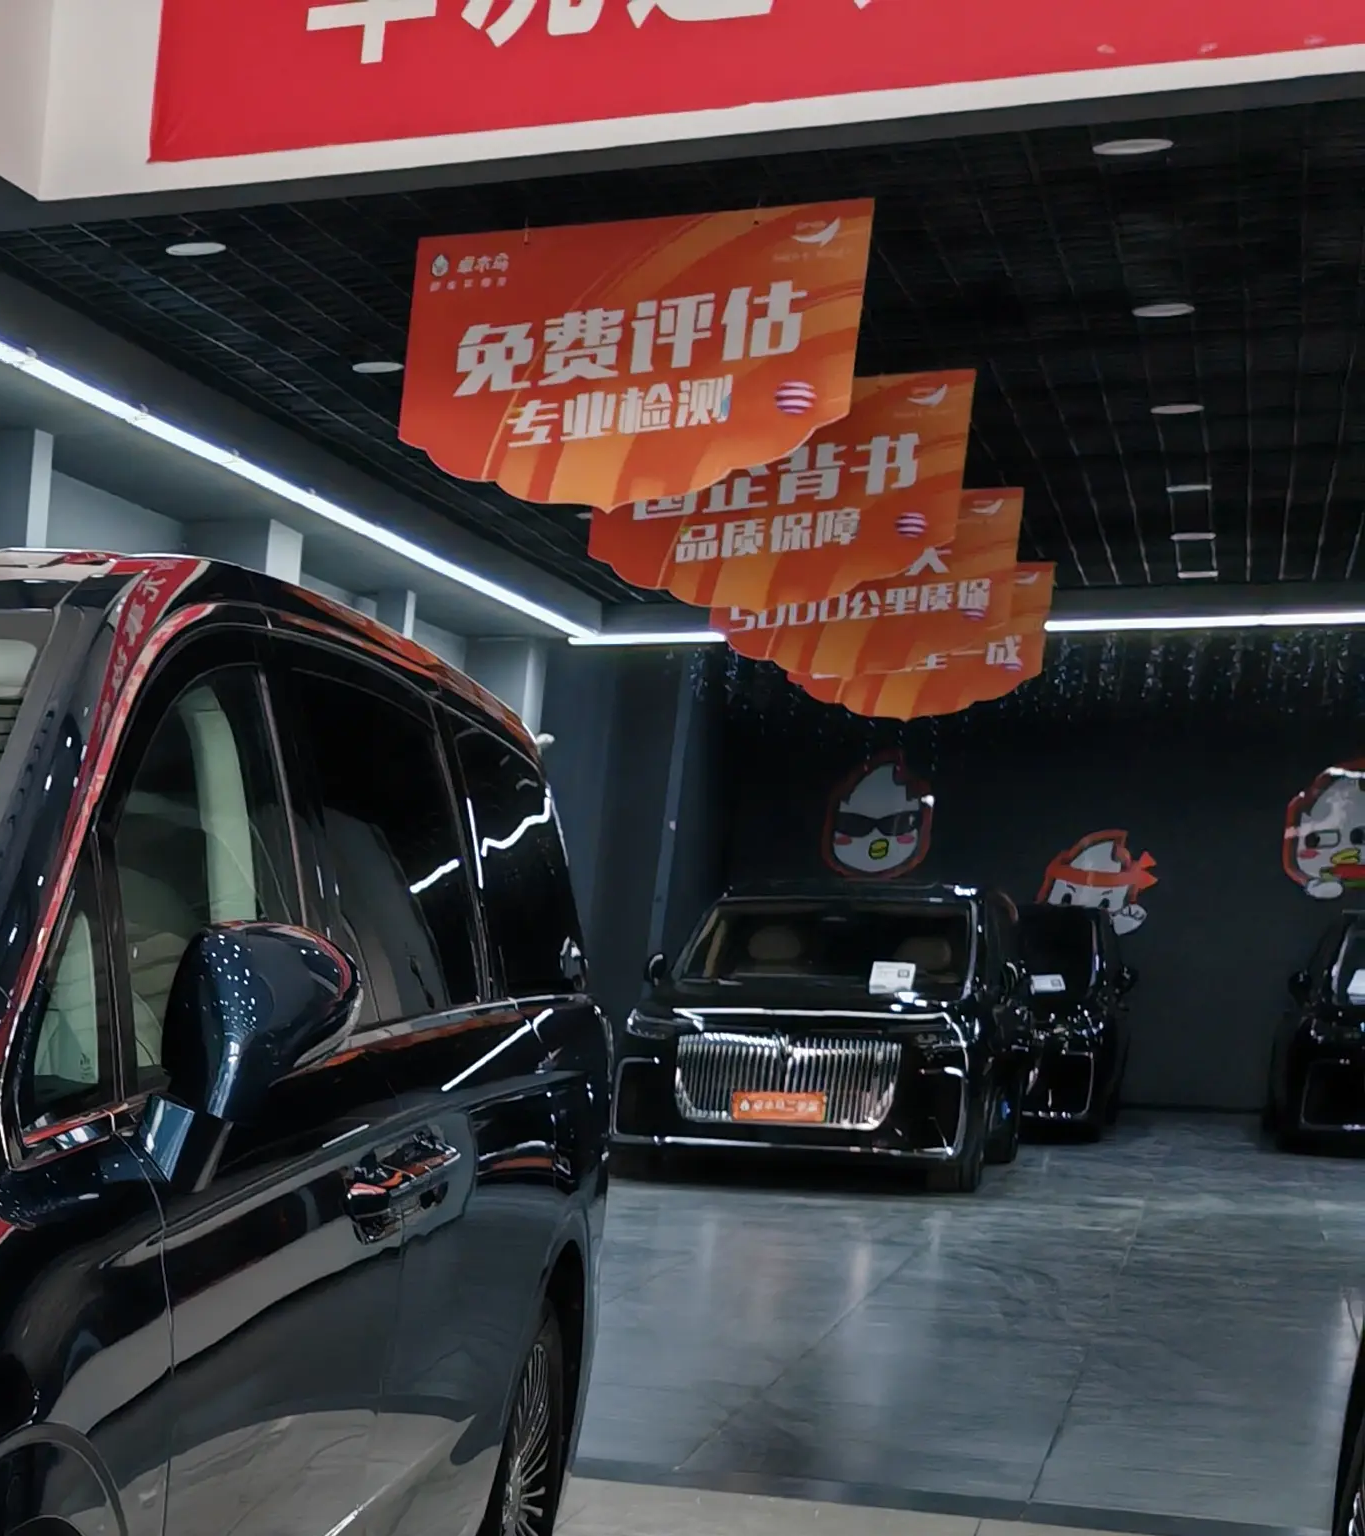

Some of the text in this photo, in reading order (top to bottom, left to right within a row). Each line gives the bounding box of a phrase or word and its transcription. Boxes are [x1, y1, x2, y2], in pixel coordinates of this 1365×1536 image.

[453, 281, 808, 397] 免费评估
[506, 374, 734, 448] 专业检测
[674, 506, 862, 563] 品质保障
